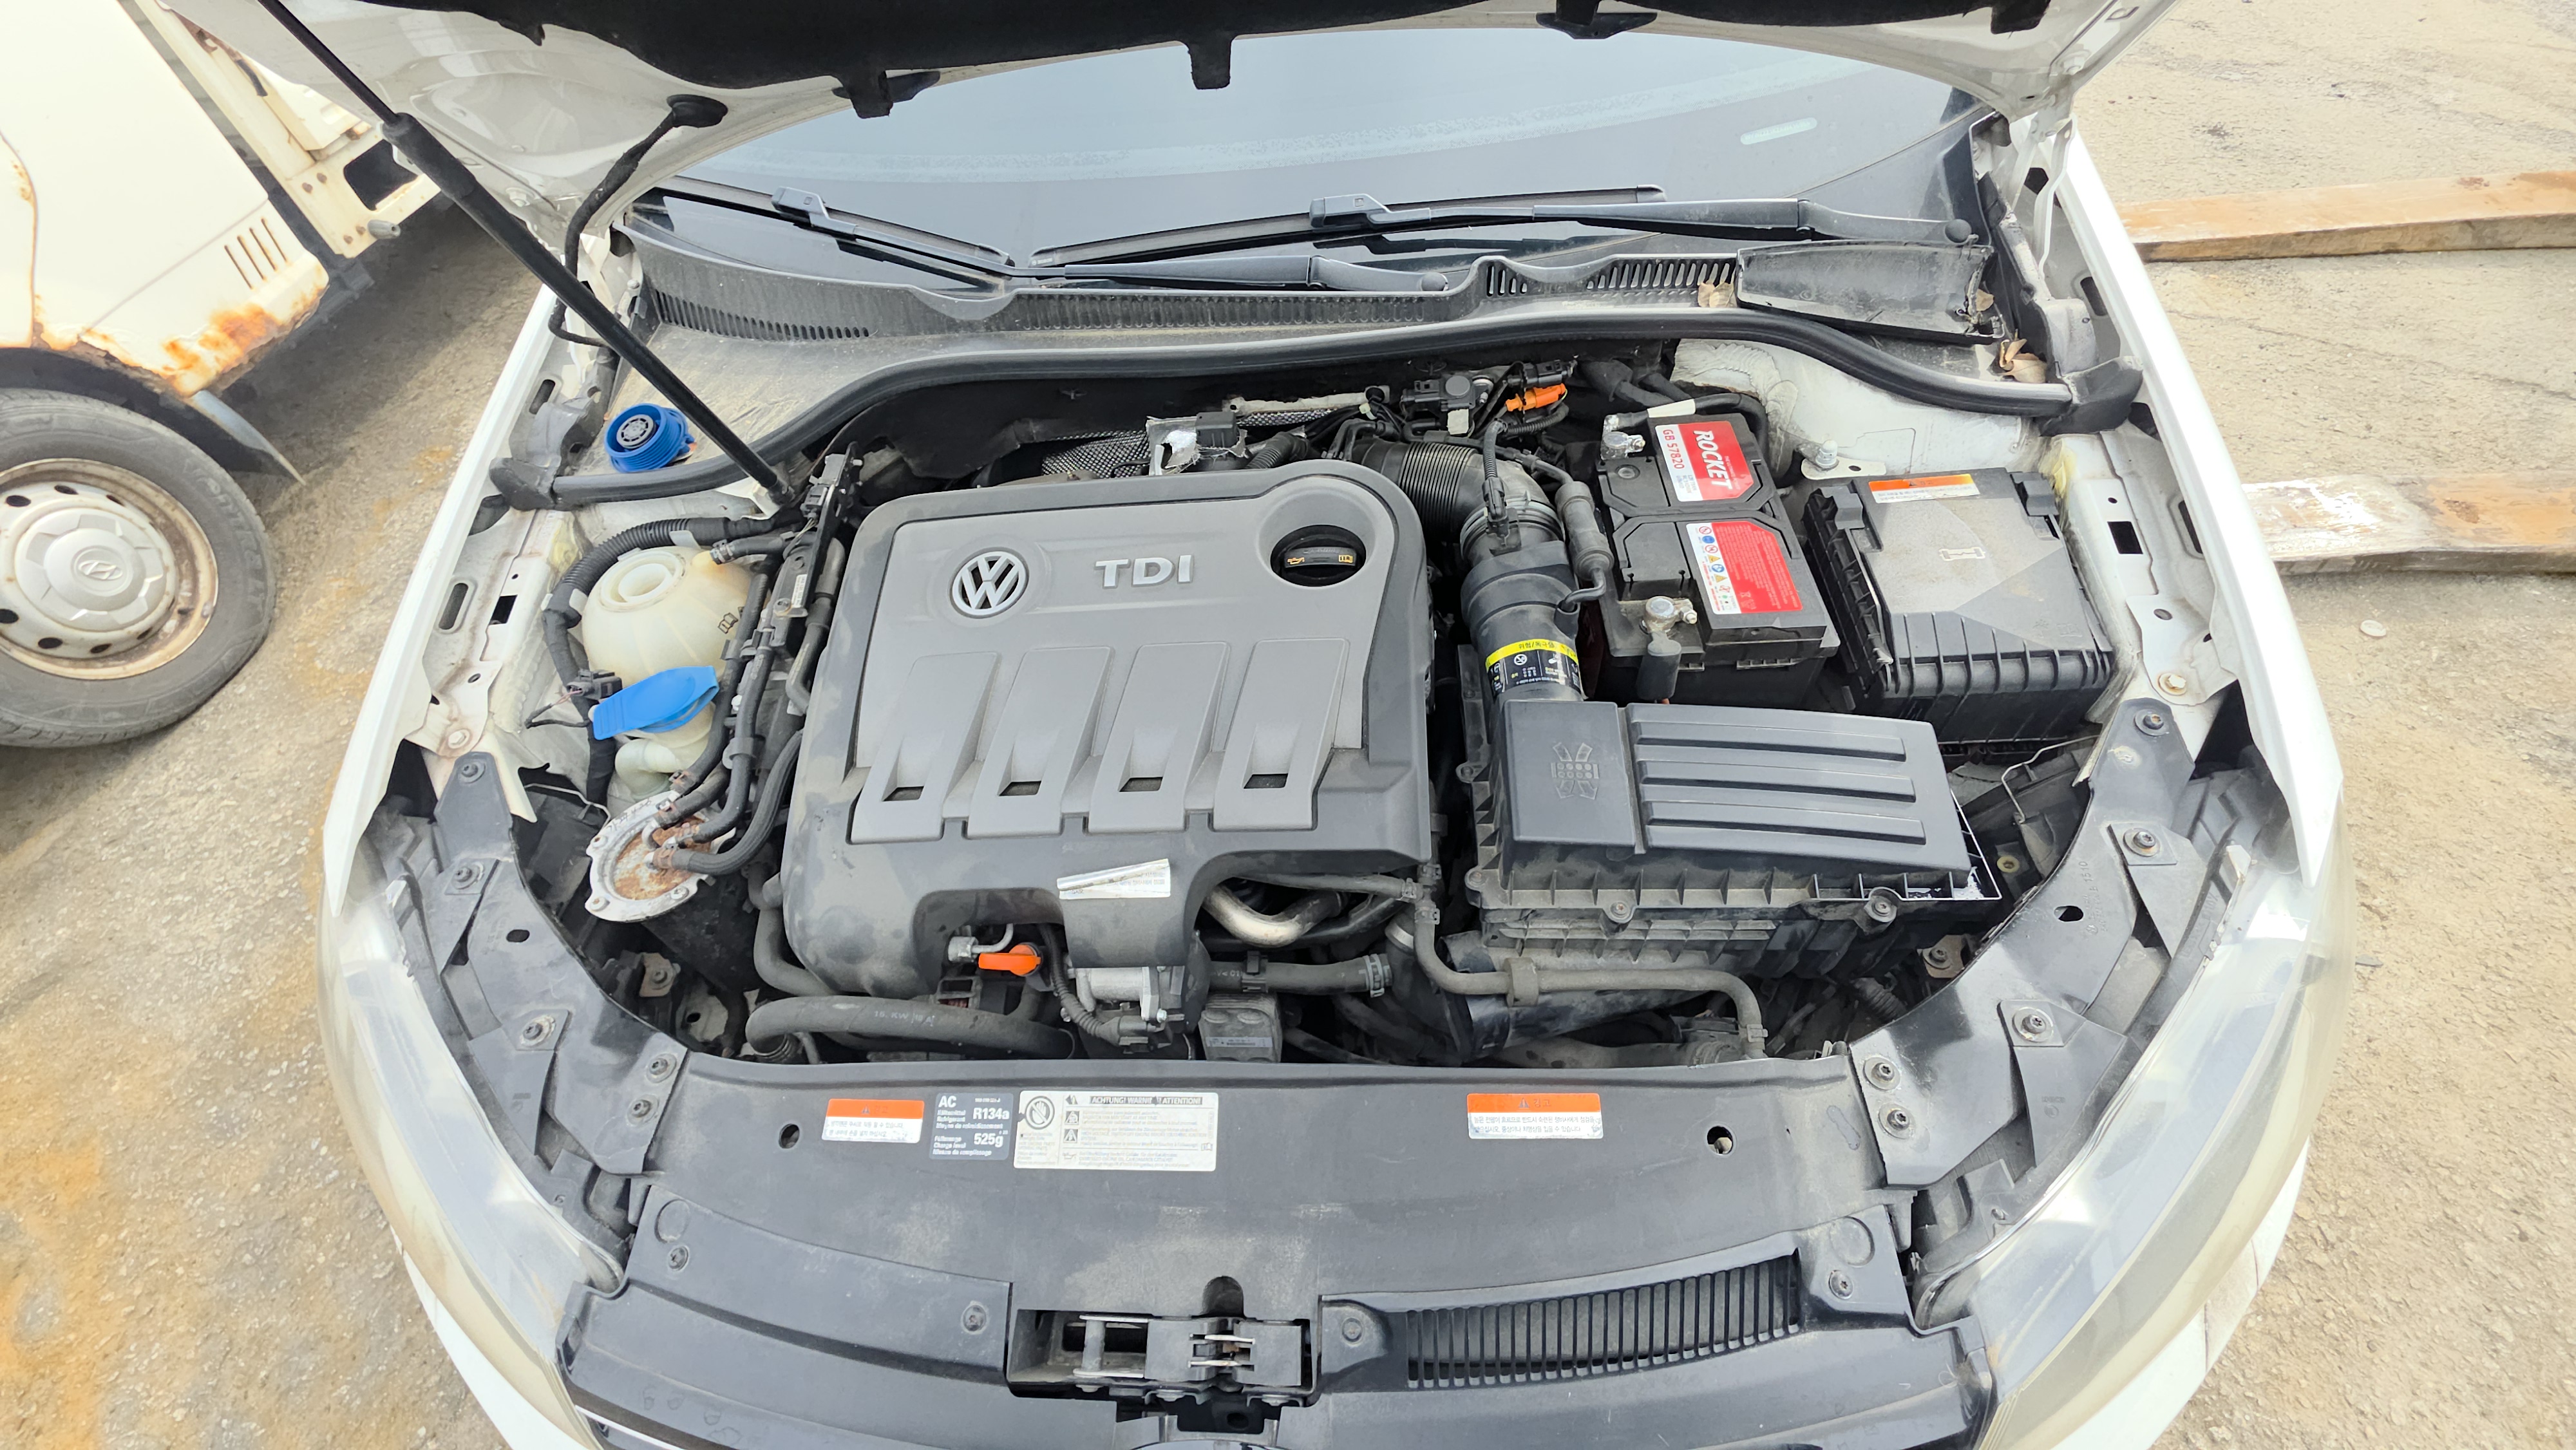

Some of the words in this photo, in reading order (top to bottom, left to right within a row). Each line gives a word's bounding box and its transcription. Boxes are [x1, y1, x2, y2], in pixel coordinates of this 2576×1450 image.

[1662, 428, 1676, 441] GB
[1666, 442, 1685, 469] 57820
[1692, 430, 1732, 489] ROCKET
[1095, 555, 1194, 590] TDI
[938, 1095, 957, 1107] AC
[1092, 1096, 1126, 1105] ACHTUNG!
[972, 1107, 1010, 1120] R134a
[974, 1133, 1003, 1147] 525g
